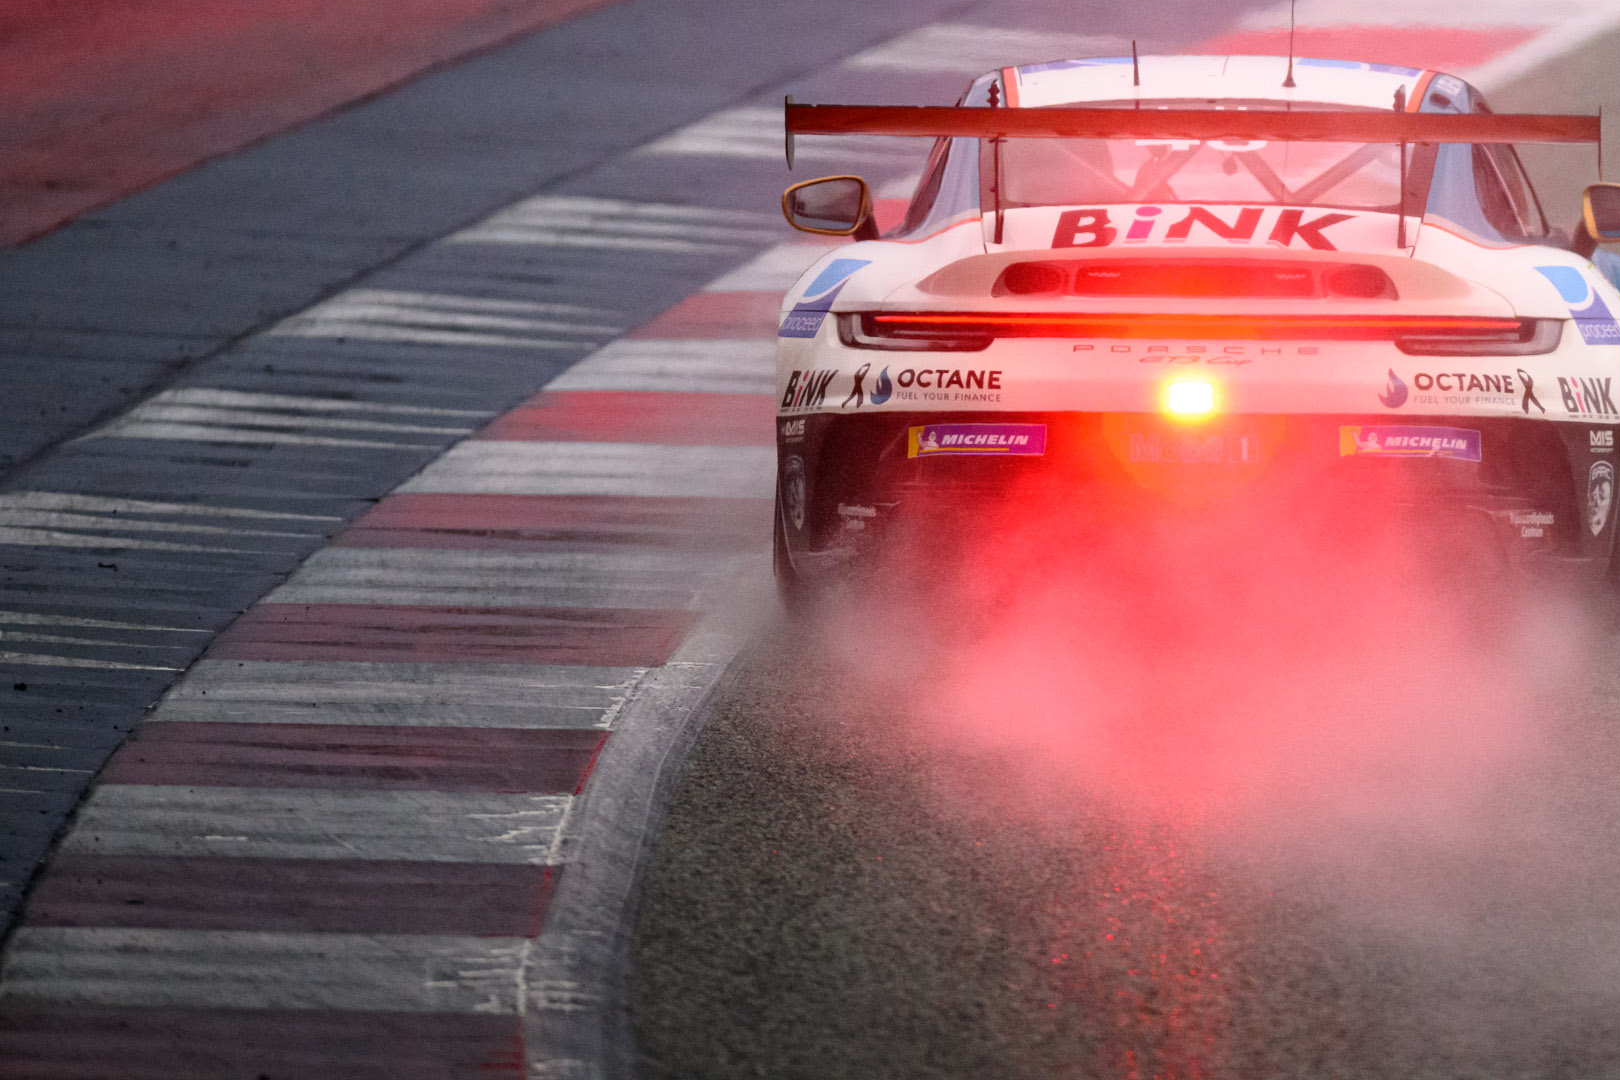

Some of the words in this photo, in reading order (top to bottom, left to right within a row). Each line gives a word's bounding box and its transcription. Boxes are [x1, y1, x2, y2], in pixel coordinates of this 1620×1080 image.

[1050, 205, 1359, 252] BiNK
[1073, 344, 1321, 356] PORSCHE
[1138, 355, 1202, 365] GT3
[1205, 355, 1253, 367] Cup
[780, 368, 839, 408] BiNK
[897, 368, 1003, 390] OCTANE
[1413, 372, 1515, 394] OCTANE
[896, 391, 918, 401] FUEL
[922, 392, 949, 402] YOUR
[954, 393, 1002, 403] FINANCE
[1413, 395, 1439, 405] FUEL
[1444, 395, 1471, 405] YOUR
[1475, 396, 1516, 407] FINANCE
[1557, 375, 1619, 416] BiNK
[940, 433, 1029, 446] MICHELIN
[1384, 435, 1468, 451] MICHELIN
[1589, 429, 1614, 447] MIS
[1129, 433, 1224, 464] Mobil
